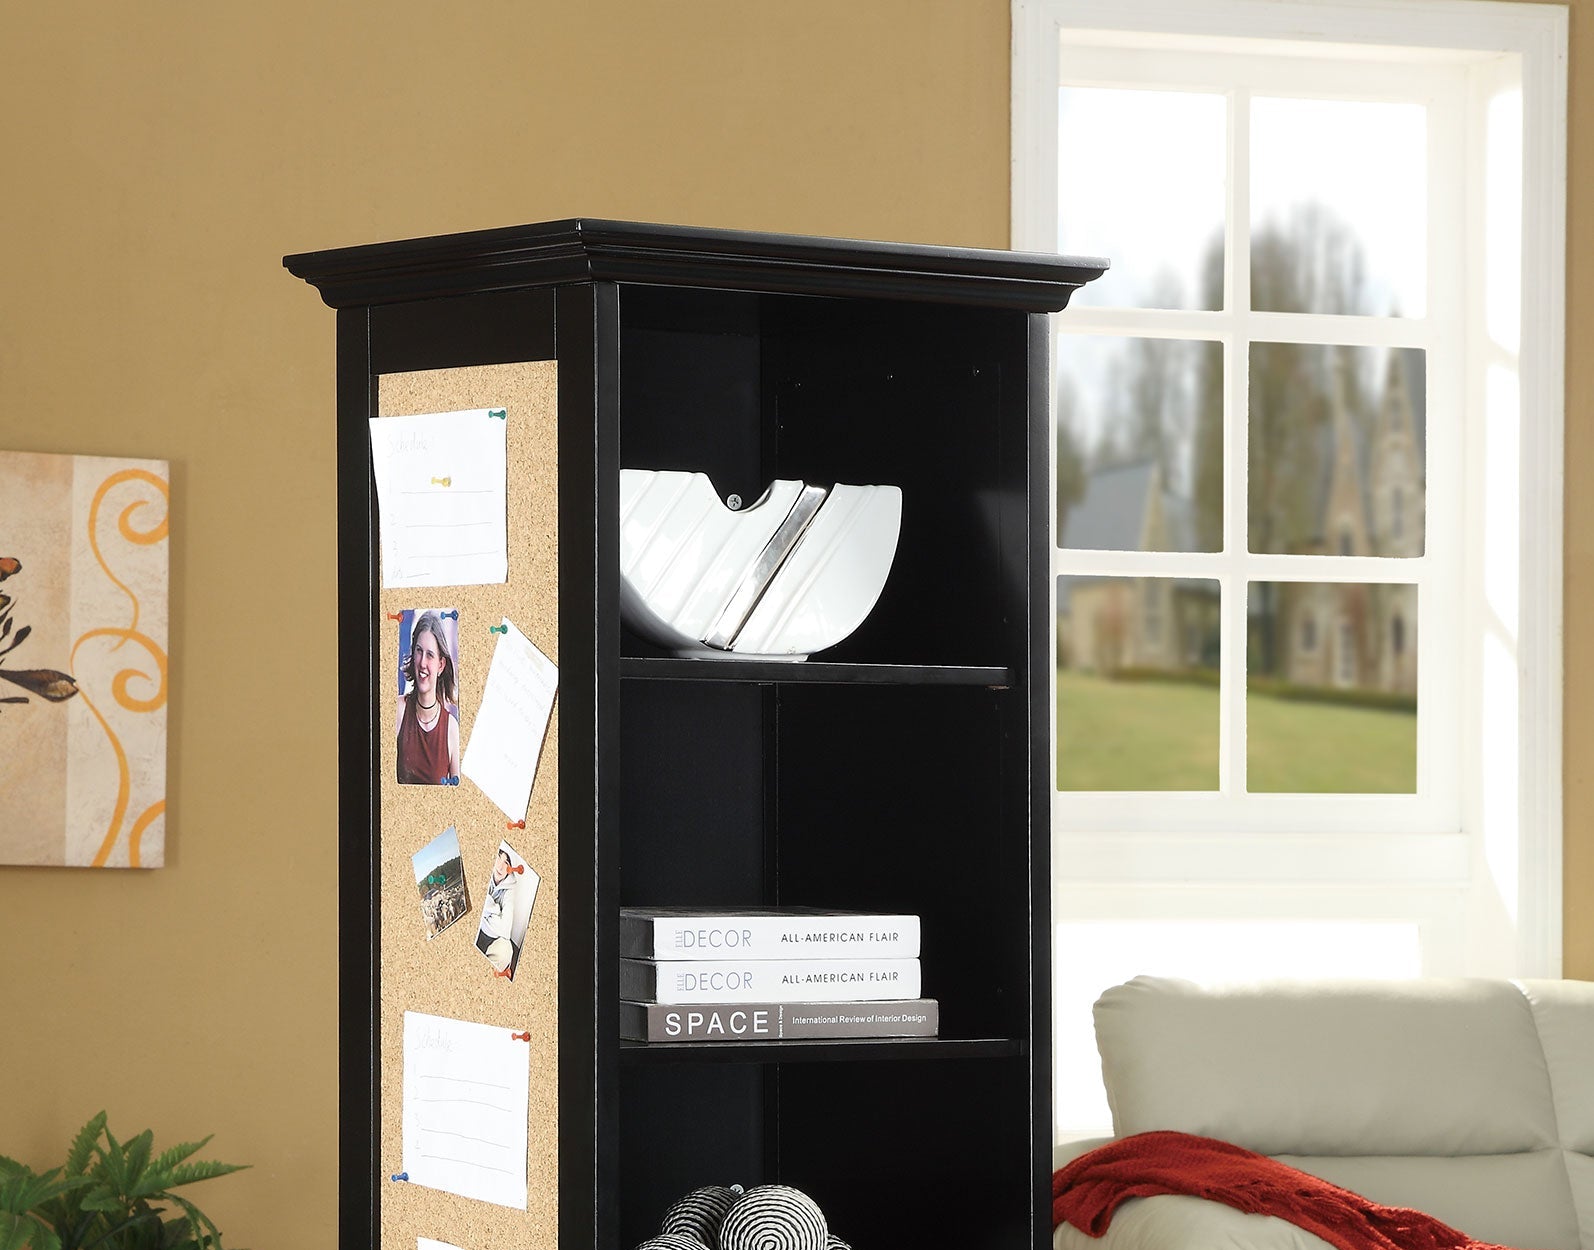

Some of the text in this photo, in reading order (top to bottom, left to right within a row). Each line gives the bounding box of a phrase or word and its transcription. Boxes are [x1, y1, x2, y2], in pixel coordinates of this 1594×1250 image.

[675, 930, 683, 948] ELLE
[683, 929, 752, 948] DECOR
[781, 932, 899, 943] ALL-AMERICAN FLAIR
[677, 974, 685, 992] ELLE
[685, 972, 753, 992] DECOR
[781, 972, 899, 984] ALL-AMERICAN FLAIR
[665, 1010, 769, 1036] SPACE
[792, 1014, 927, 1025] International Review of Interior Design
